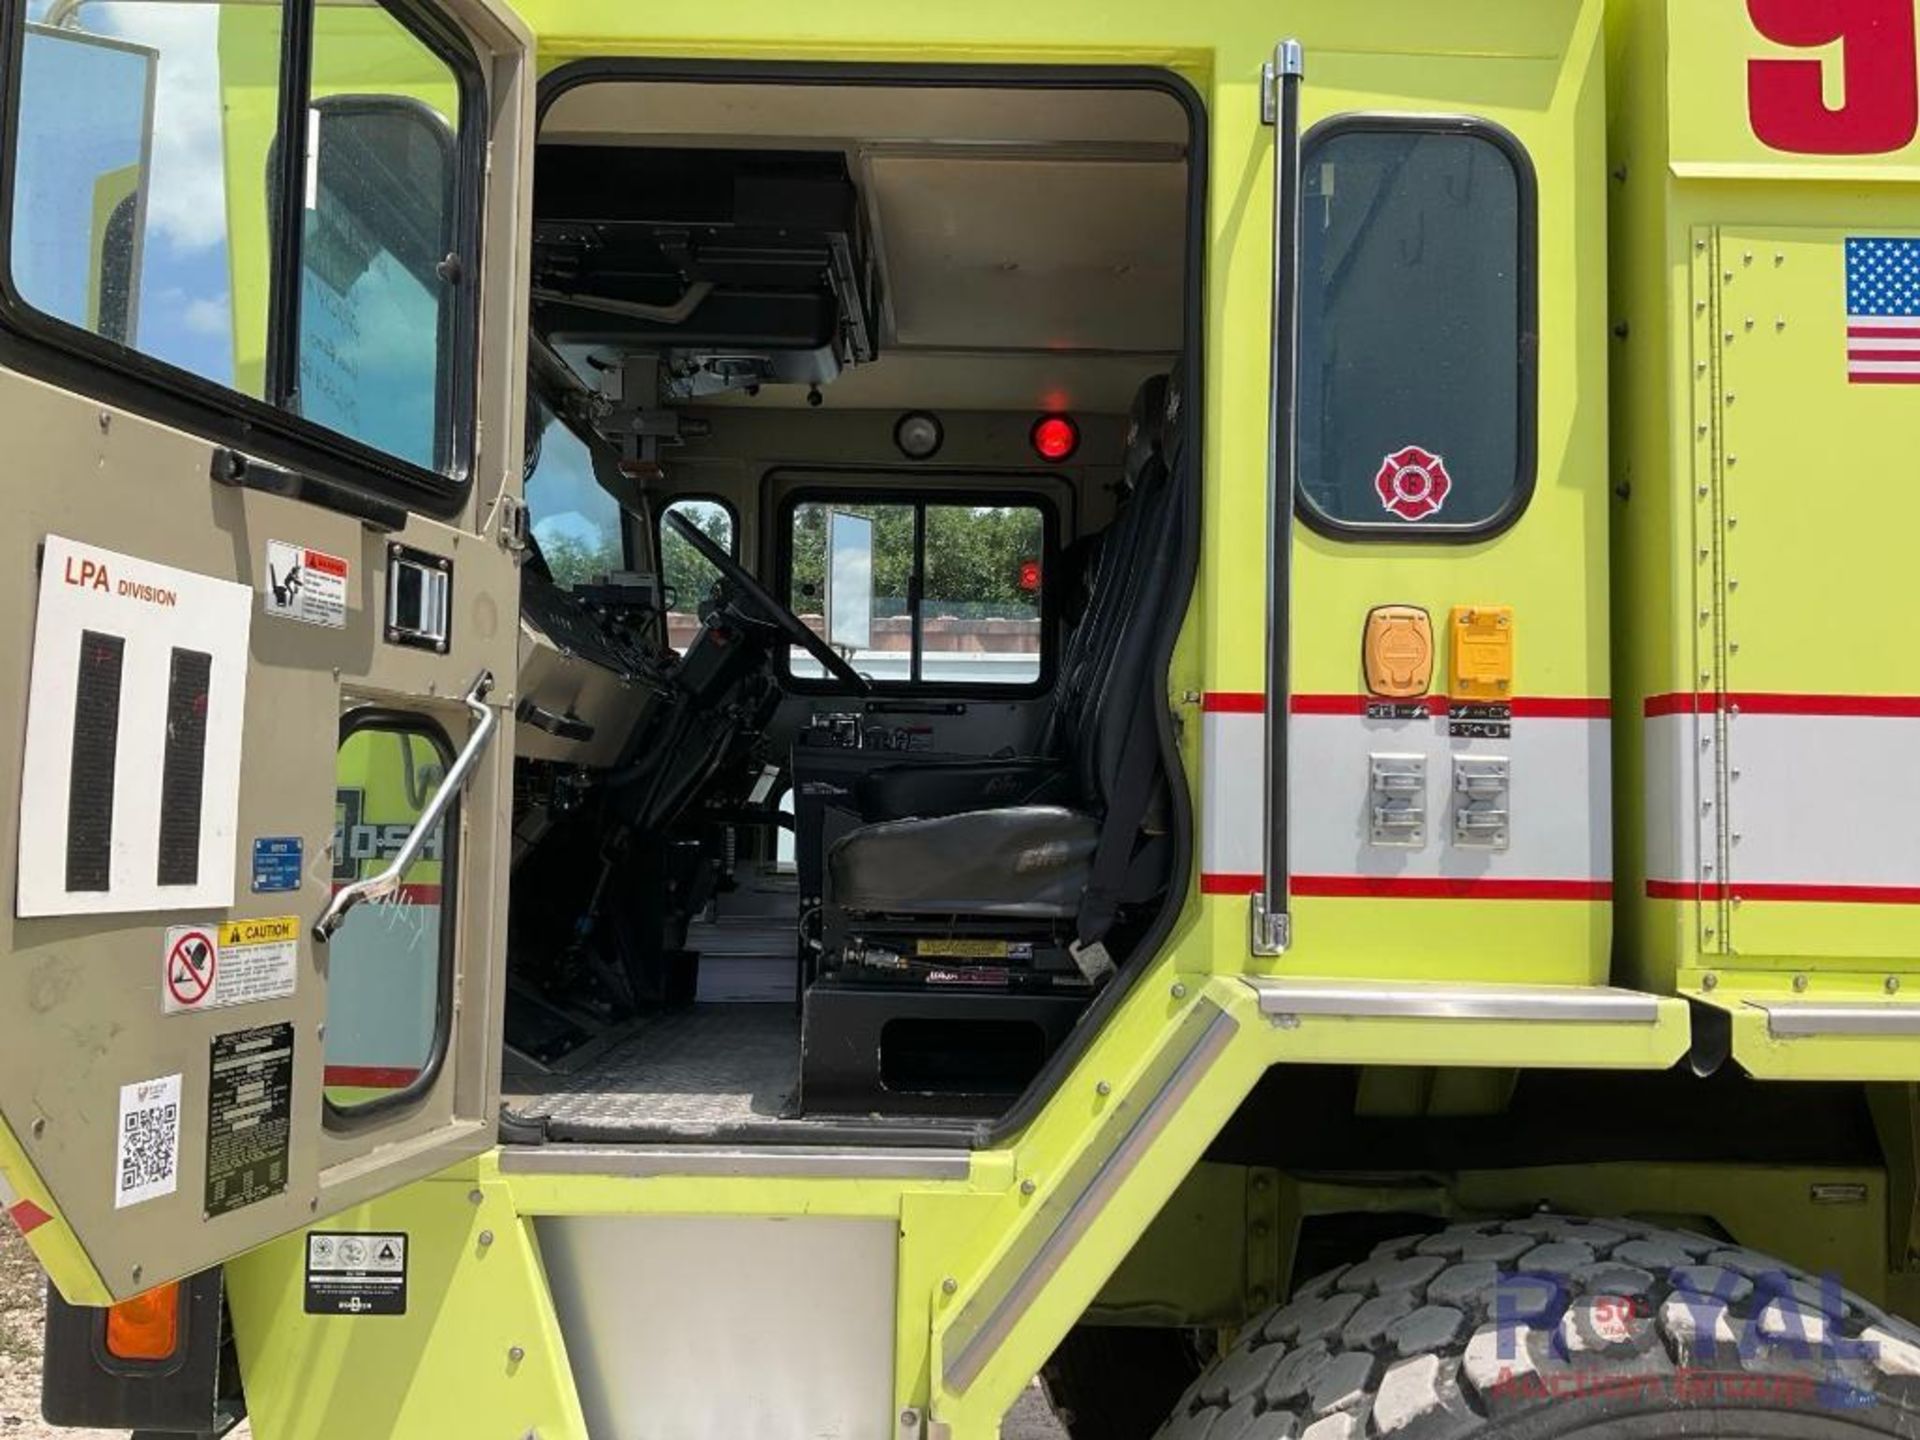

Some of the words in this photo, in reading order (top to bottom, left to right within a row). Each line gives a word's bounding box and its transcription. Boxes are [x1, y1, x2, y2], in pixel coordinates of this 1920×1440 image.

[1746, 0, 1918, 155] 9
[65, 556, 110, 592] LPA
[118, 579, 177, 607] DIVISION
[246, 922, 290, 940] CAUTION
